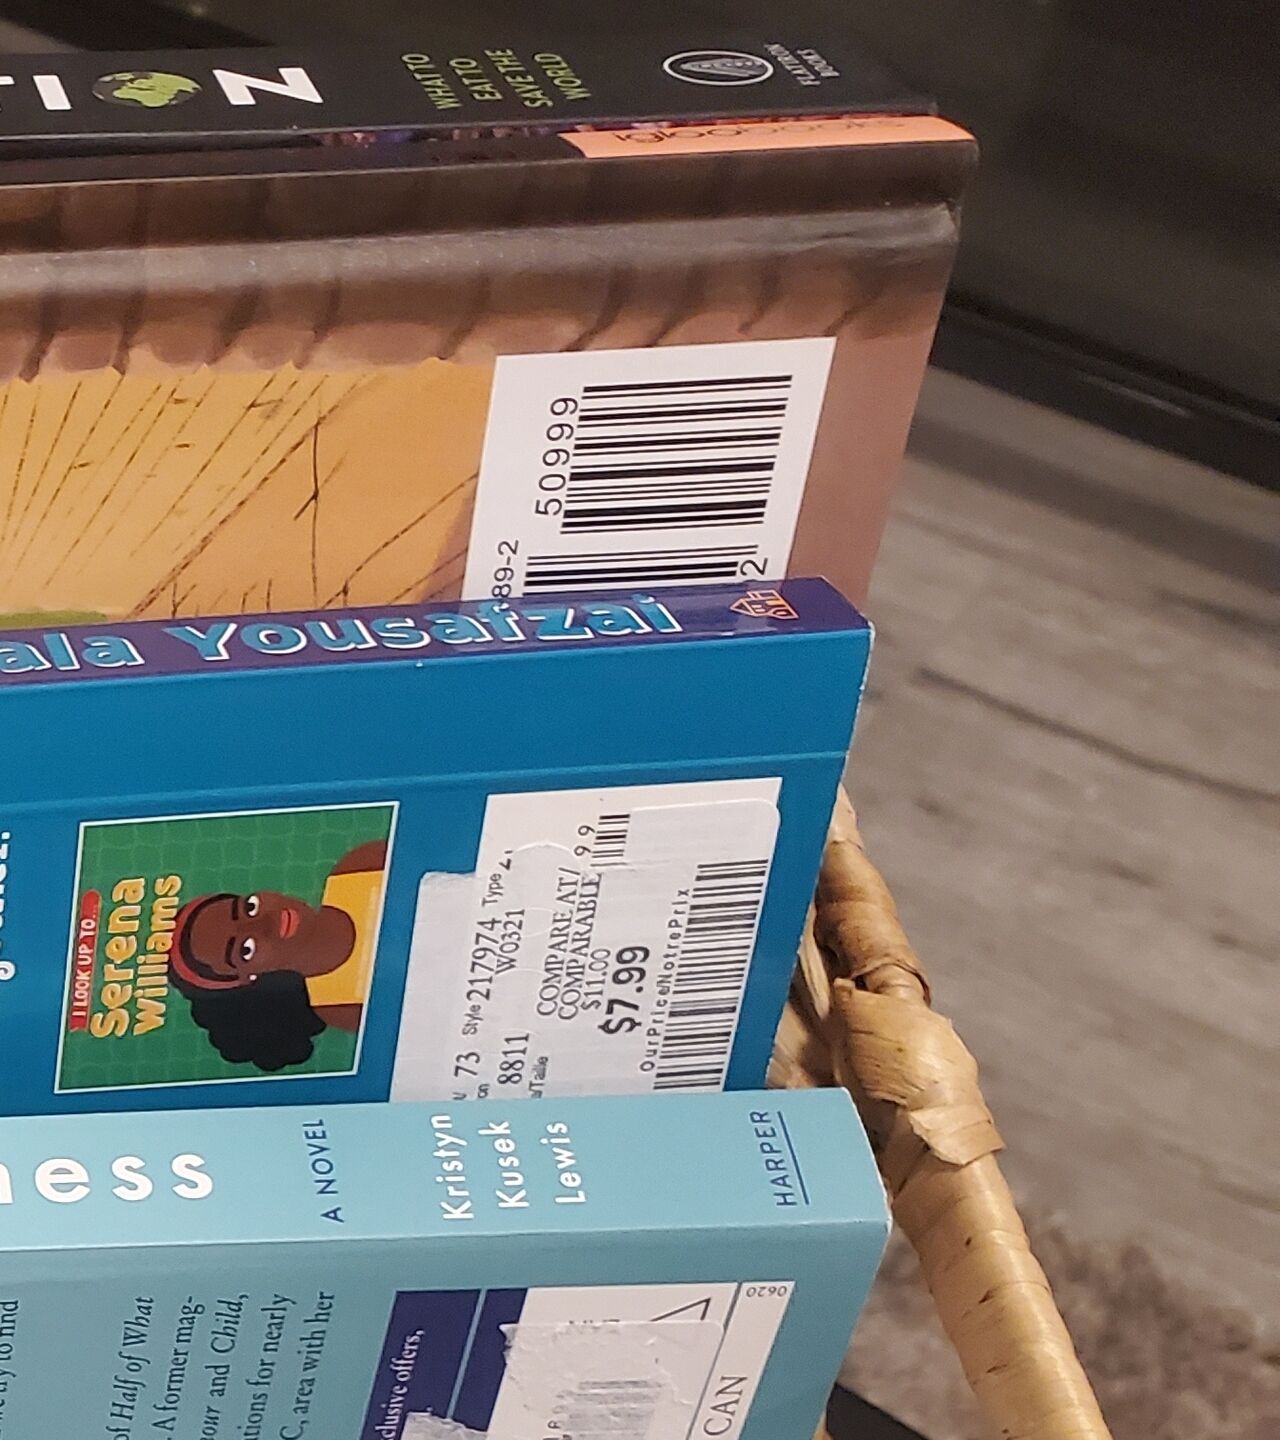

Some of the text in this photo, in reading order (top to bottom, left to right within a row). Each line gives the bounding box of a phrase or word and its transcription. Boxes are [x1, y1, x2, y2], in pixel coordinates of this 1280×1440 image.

[401, 54, 463, 109] WHAT TO
[449, 58, 503, 101] EAT TO
[485, 49, 553, 108] SAVE THE
[534, 53, 592, 100] WORLD
[763, 44, 821, 86] FLATIRON
[797, 49, 840, 77] BOOKS
[535, 396, 579, 516] 50999
[163, 593, 685, 662] Yousafzai
[480, 872, 504, 908] Type
[76, 943, 95, 966] UP
[89, 877, 145, 1039] Serena
[466, 917, 502, 1001] 217974
[536, 908, 574, 1017] COMPARE
[557, 871, 606, 1021] COMPARABLE
[72, 968, 92, 1007] LOOK
[580, 948, 612, 1012] $11.00
[597, 945, 651, 1035] $7.99
[71, 1009, 88, 1017] I
[462, 1003, 484, 1036] Style
[453, 1051, 481, 1078] 73
[497, 1033, 531, 1085] 8811
[302, 1118, 345, 1224] A NOVEL
[430, 1113, 475, 1221] Kristyn
[478, 1119, 531, 1210] Kusek
[539, 1121, 587, 1204] Lewis
[748, 1111, 797, 1207] HARPER
[121, 1295, 154, 1346] What
[117, 1350, 151, 1372] of
[391, 1328, 426, 1384] offers,
[109, 1374, 147, 1420] Half
[703, 1376, 749, 1437] CAN
